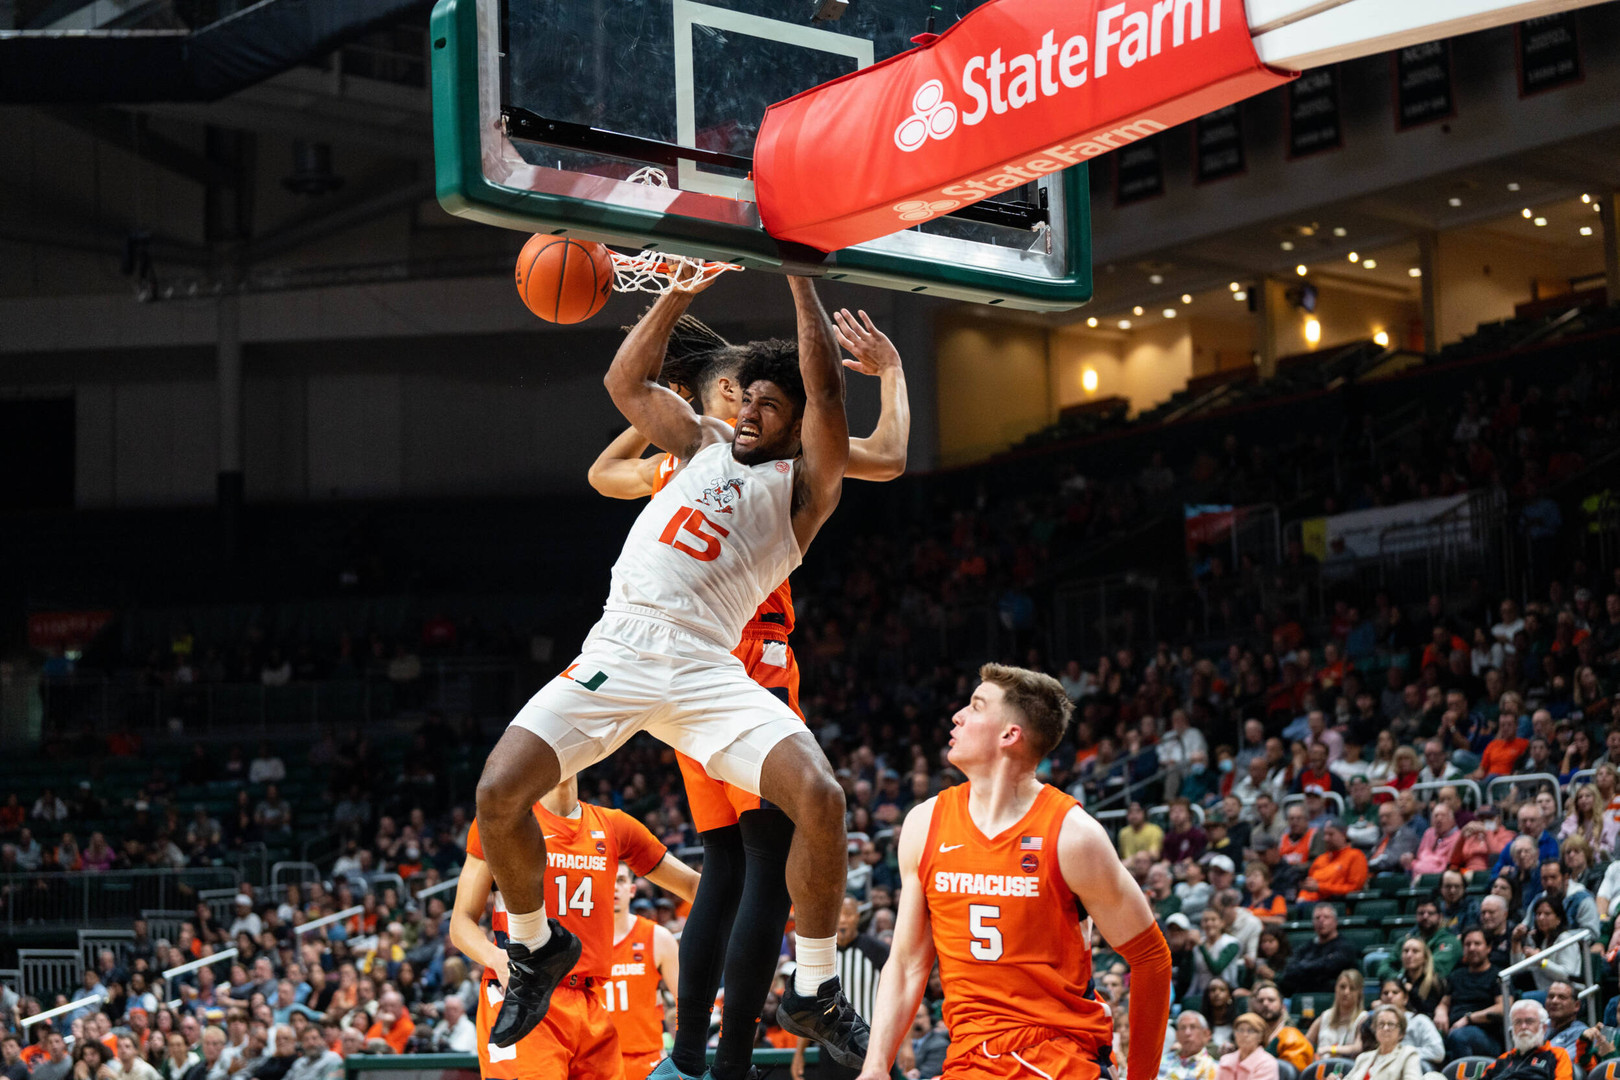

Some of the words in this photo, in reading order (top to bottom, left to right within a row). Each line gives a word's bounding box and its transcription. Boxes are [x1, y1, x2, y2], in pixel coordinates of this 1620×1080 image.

[658, 506, 730, 561] 15
[546, 852, 607, 871] YRACUSE
[554, 875, 594, 917] 14
[935, 871, 1040, 897] SYRACUSE
[969, 903, 1003, 962] 5
[611, 963, 646, 977] CUSE
[603, 980, 629, 1012] 11
